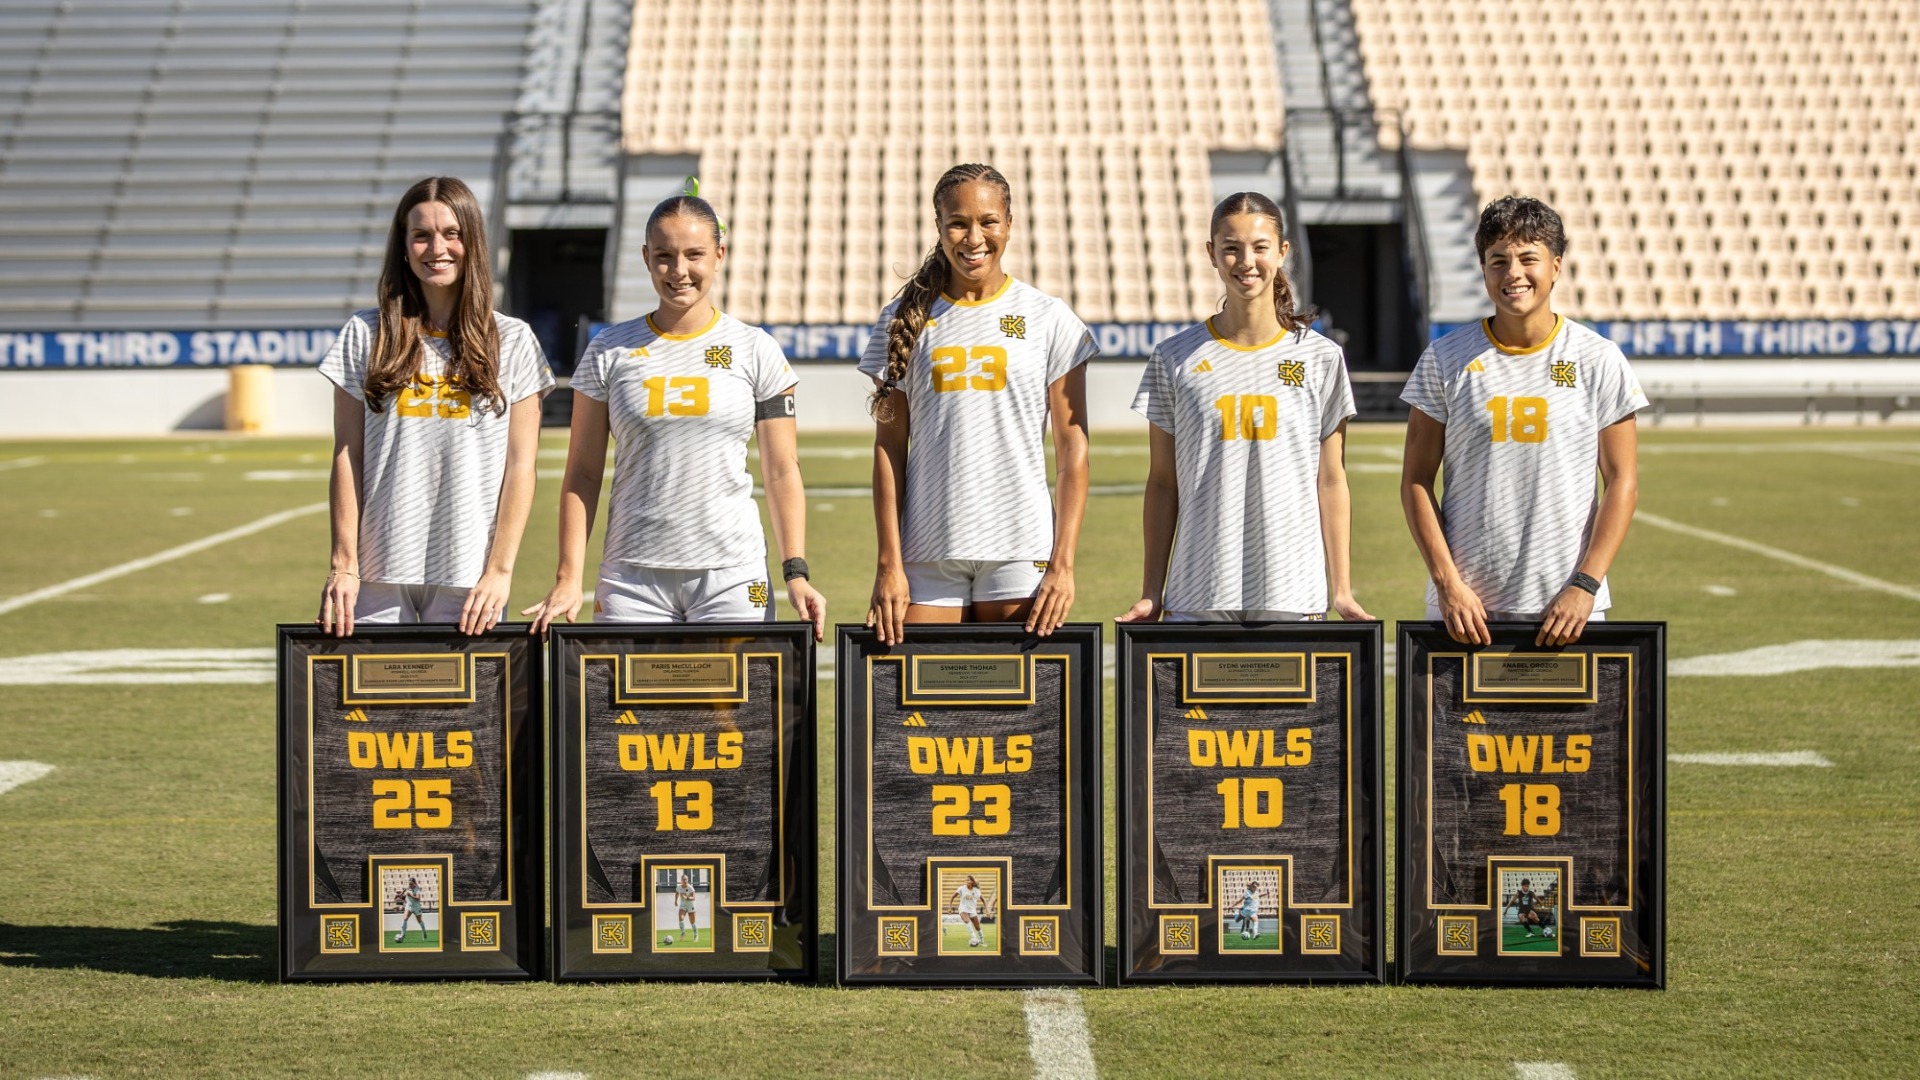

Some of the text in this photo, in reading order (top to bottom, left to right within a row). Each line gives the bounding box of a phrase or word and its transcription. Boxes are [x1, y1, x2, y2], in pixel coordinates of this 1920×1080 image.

[56, 332, 180, 366] THIRD
[1608, 321, 1721, 356] FIFTH
[1734, 321, 1855, 355] THIRD
[931, 345, 1008, 393] 23
[396, 373, 471, 419] 25
[643, 376, 710, 417] 13
[784, 395, 795, 416] C
[1214, 394, 1278, 441] 10
[1486, 395, 1548, 443] 18
[347, 730, 473, 769] OWLS
[617, 731, 743, 771] OWLS
[907, 734, 1033, 775] OWLS
[1187, 727, 1312, 767] OWLS
[1466, 733, 1592, 773] OWLS
[372, 779, 453, 829] 25
[650, 780, 714, 831] 13
[931, 784, 1011, 836] 23
[1216, 777, 1284, 829] 10
[1499, 783, 1561, 836] 18
